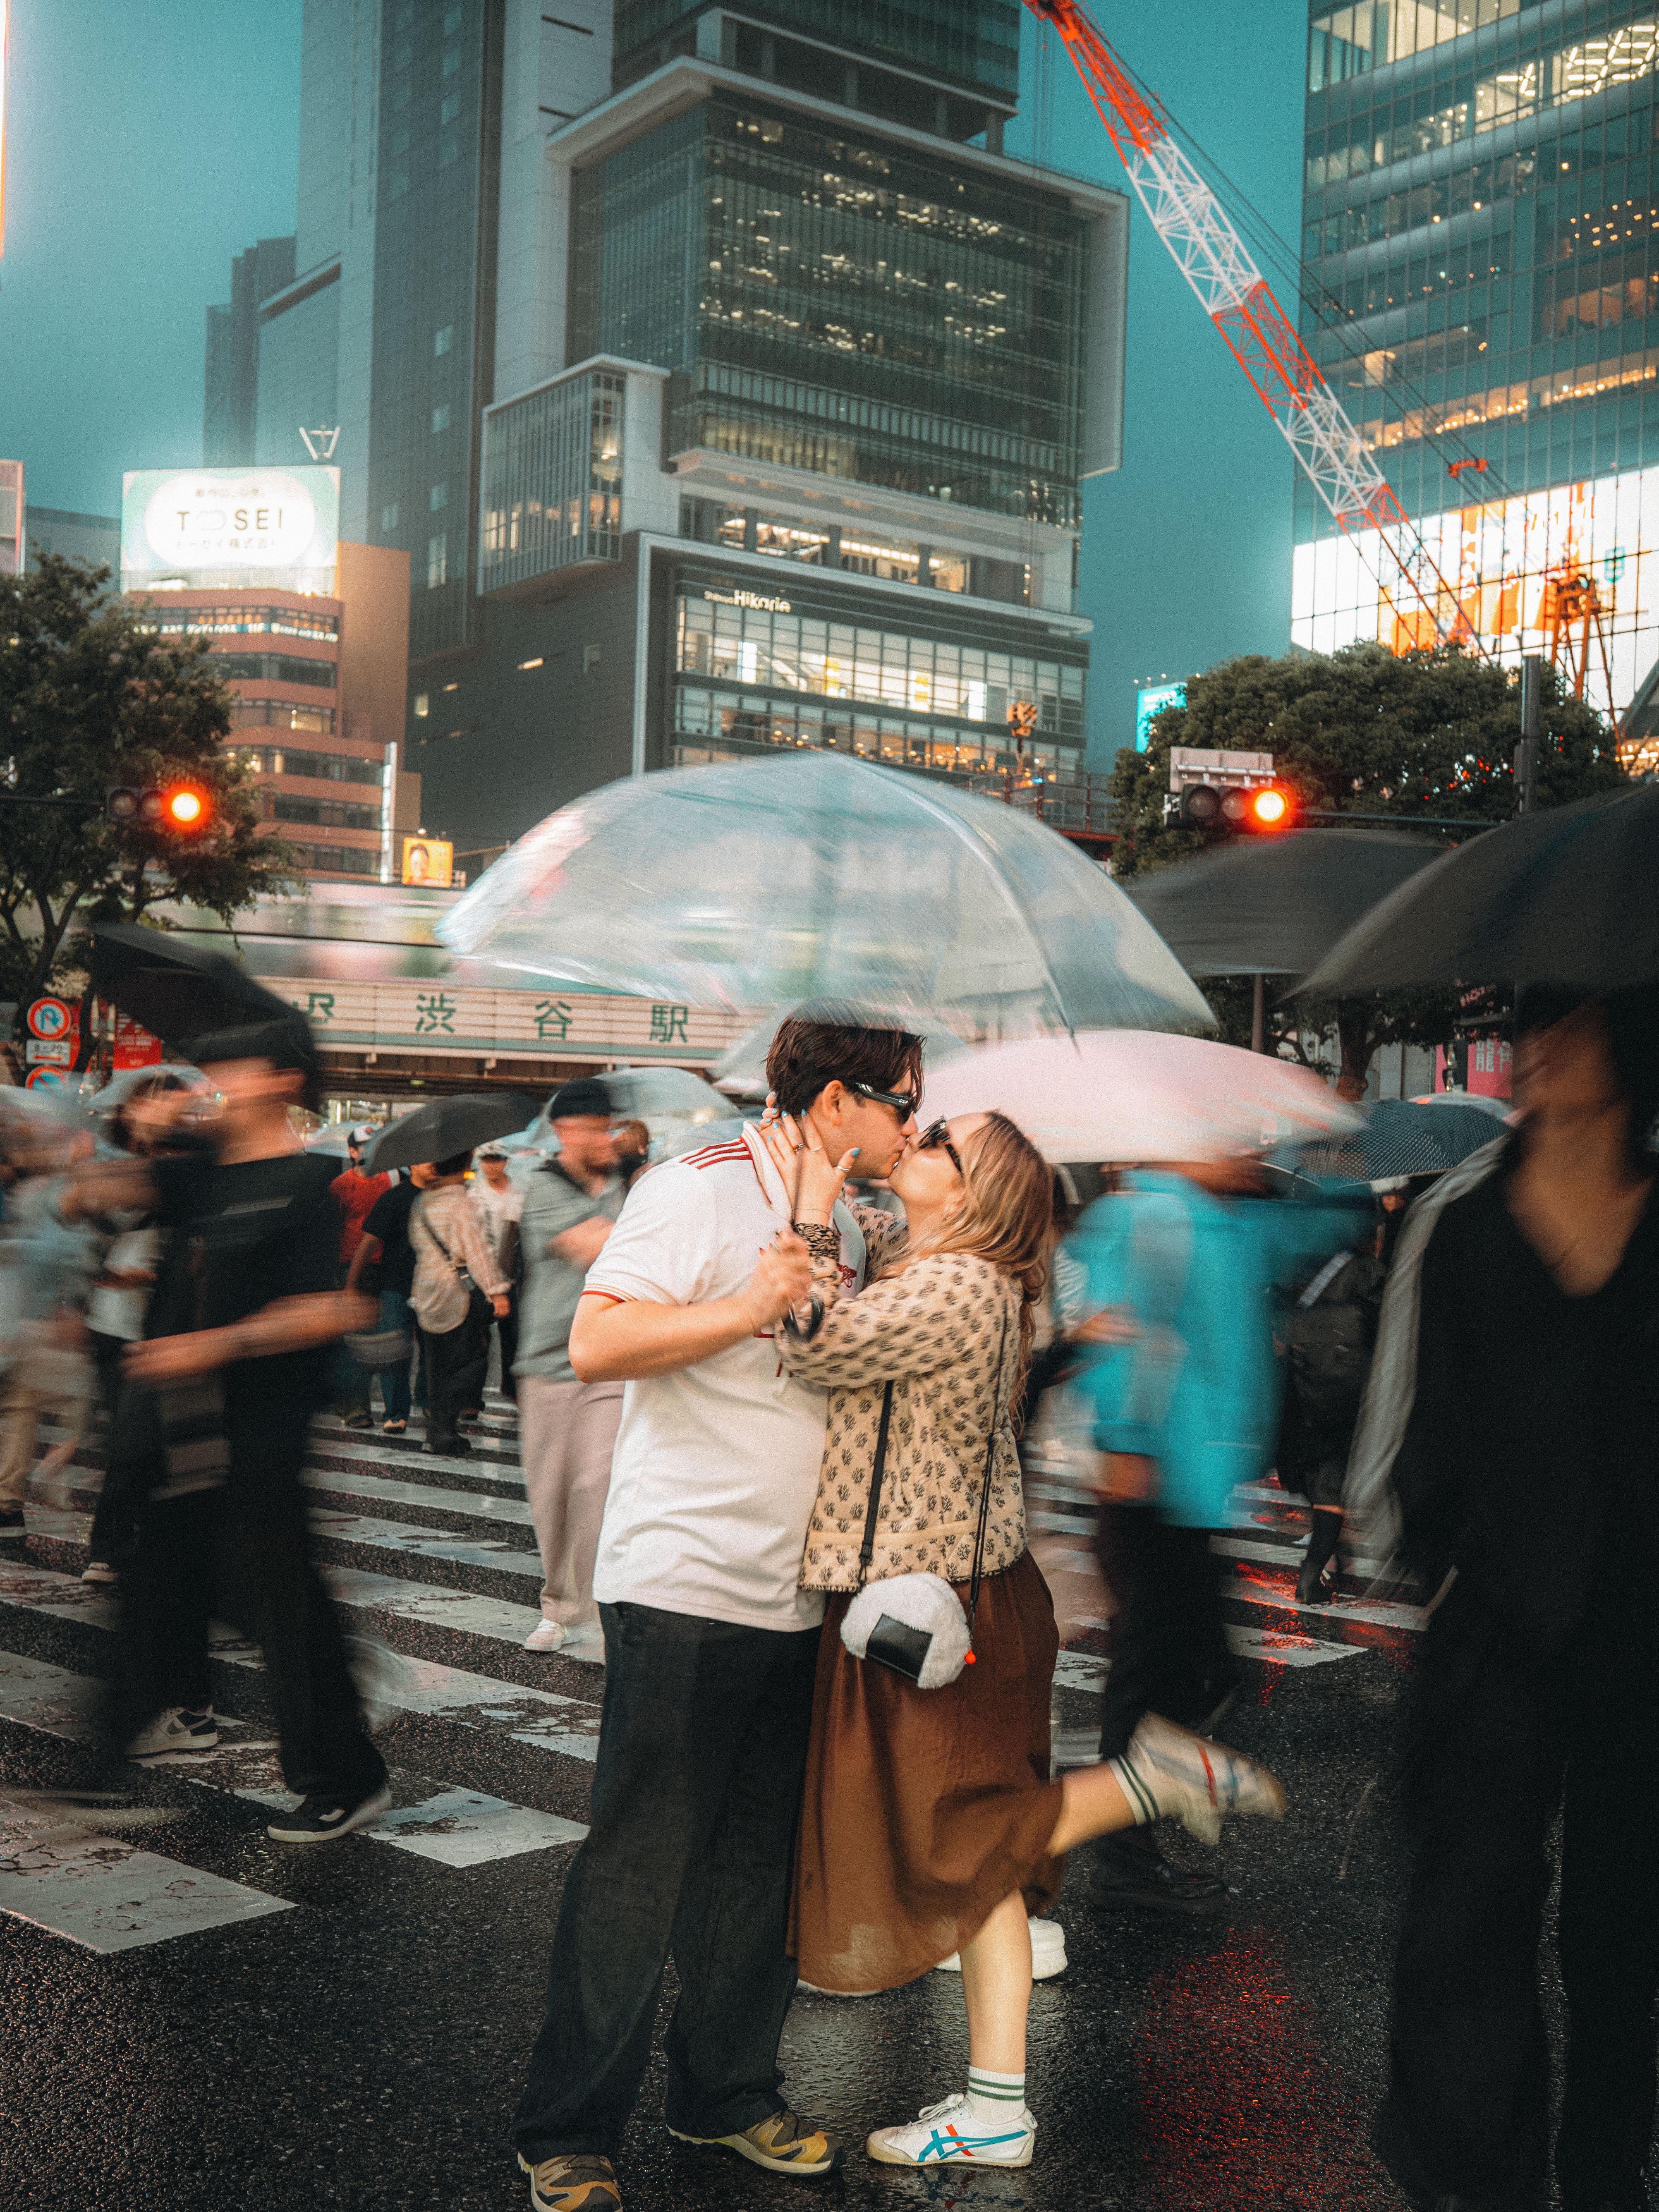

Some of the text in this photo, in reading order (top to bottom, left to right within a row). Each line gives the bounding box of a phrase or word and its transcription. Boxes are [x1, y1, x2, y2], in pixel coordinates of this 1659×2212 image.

[734, 589, 791, 613] Hikarie
[415, 993, 689, 1043] 渋谷駅
